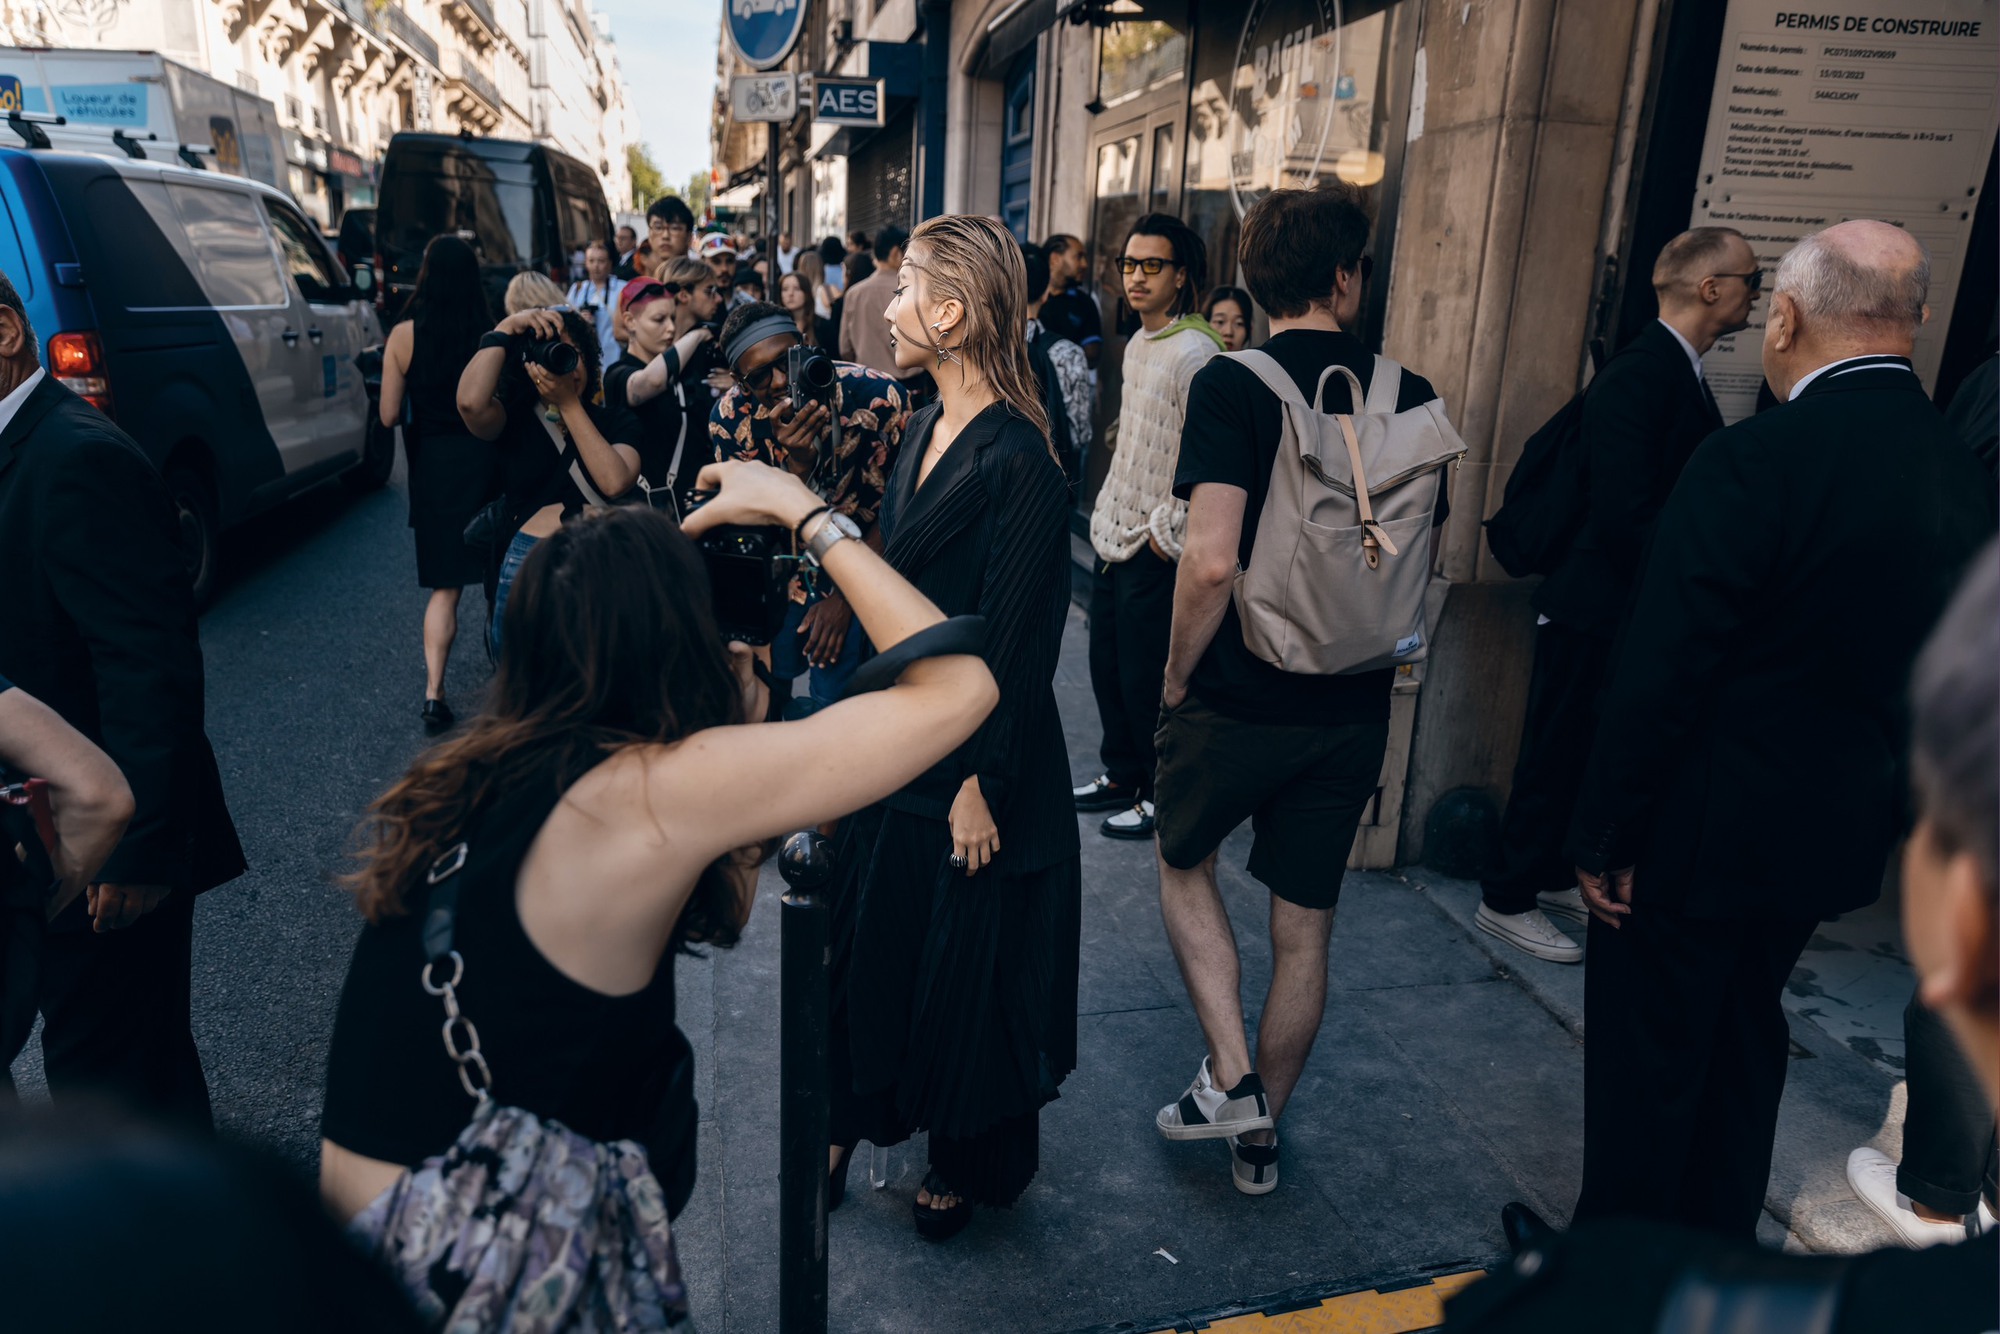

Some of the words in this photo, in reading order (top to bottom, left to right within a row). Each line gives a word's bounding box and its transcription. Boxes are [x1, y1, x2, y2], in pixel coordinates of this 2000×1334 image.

[1775, 13, 1841, 30] PERMIS
[1843, 16, 1869, 32] DE
[1872, 18, 1982, 37] CONSTRUIRE
[1740, 43, 1769, 52] Numéro
[1769, 44, 1779, 53] du
[1779, 46, 1804, 55] permis
[1252, 24, 1314, 102] BAGEL
[1736, 64, 1753, 73] Date
[1754, 65, 1763, 74] de
[1764, 66, 1800, 76] délivrance
[119, 92, 136, 105] de
[819, 89, 877, 114] AES
[1728, 105, 1753, 114] Nature
[1753, 107, 1763, 115] du
[1763, 108, 1785, 117] projet
[1731, 123, 1777, 133] Modification
[1865, 131, 1910, 140] construction
[1762, 136, 1771, 144] de
[1772, 138, 1803, 146] sous-sol
[1726, 145, 1753, 155] Surface
[1724, 157, 1753, 165] Travaux
[1753, 160, 1796, 169] comportant
[1796, 161, 1809, 169] des
[1722, 168, 1749, 177] Surface
[1709, 211, 1725, 220] Nom
[1726, 212, 1735, 220] de
[1795, 216, 1804, 224] du
[1804, 217, 1825, 226] projet
